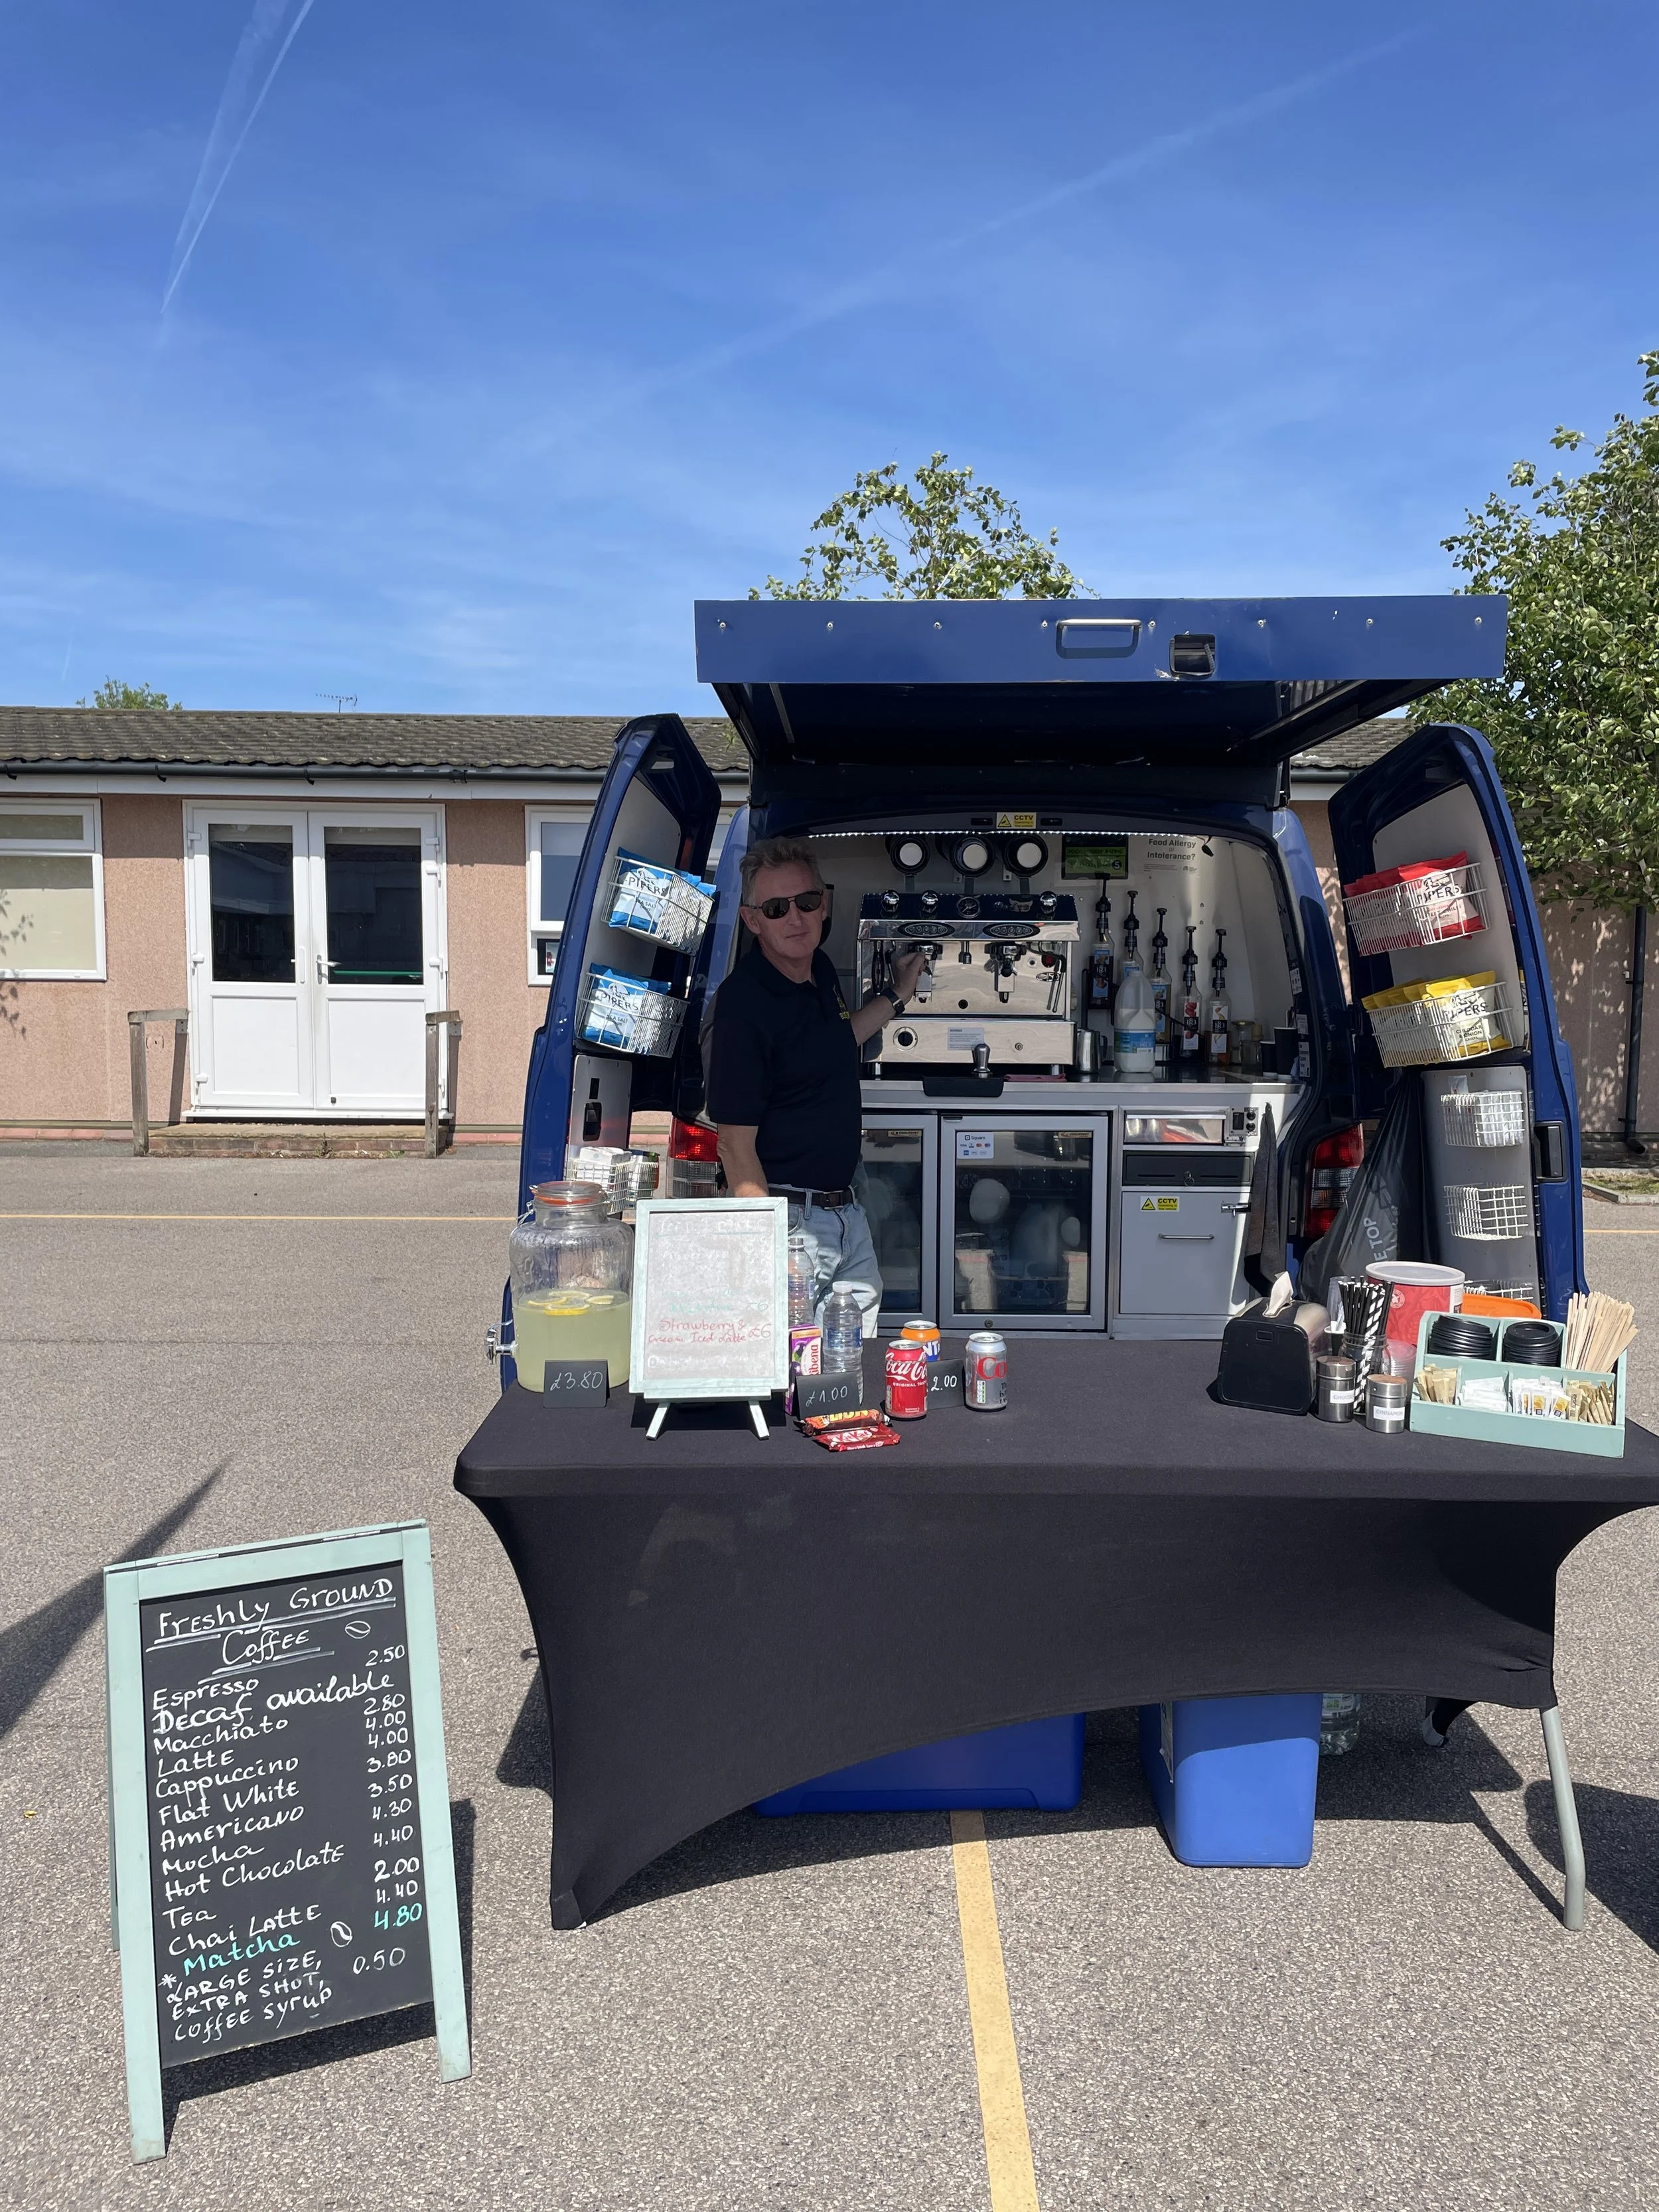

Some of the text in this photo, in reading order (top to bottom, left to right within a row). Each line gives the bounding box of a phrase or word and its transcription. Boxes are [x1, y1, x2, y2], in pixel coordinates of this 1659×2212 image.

[1147, 851, 1195, 860] Intolerance?
[1169, 840, 1196, 848] Allergy
[599, 994, 639, 1011] PIPERS
[1363, 1217, 1383, 1249] TOP
[659, 1318, 747, 1337] Strawberry &
[690, 1331, 713, 1343] Iced
[748, 1323, 772, 1339] £6
[809, 1345, 820, 1375] ibena
[549, 1370, 603, 1391] £3.80
[930, 1375, 958, 1392] 2.00
[805, 1386, 848, 1408] £1.00
[365, 1644, 405, 1666] 2.50
[265, 1670, 395, 1711] available
[153, 1693, 405, 1755] Macchiato 2.80
[366, 1710, 406, 1732] 4.00
[155, 1727, 409, 1808] Cappuccino 4.00
[159, 1798, 211, 1826] Flat
[366, 1749, 411, 1773] 3.80
[368, 1773, 413, 1798] 3.50
[162, 1798, 412, 1876] Mocha 4.30
[165, 1873, 211, 1902] Hot
[374, 1825, 413, 1848] 4.40
[162, 1856, 420, 1929] Tea 2.00
[169, 1925, 238, 1956] Chai
[376, 1880, 419, 1904] 4.40
[183, 1903, 423, 1976] Matcha 4.80
[166, 1968, 252, 2004] LARGE
[352, 1947, 406, 1974] 0.50
